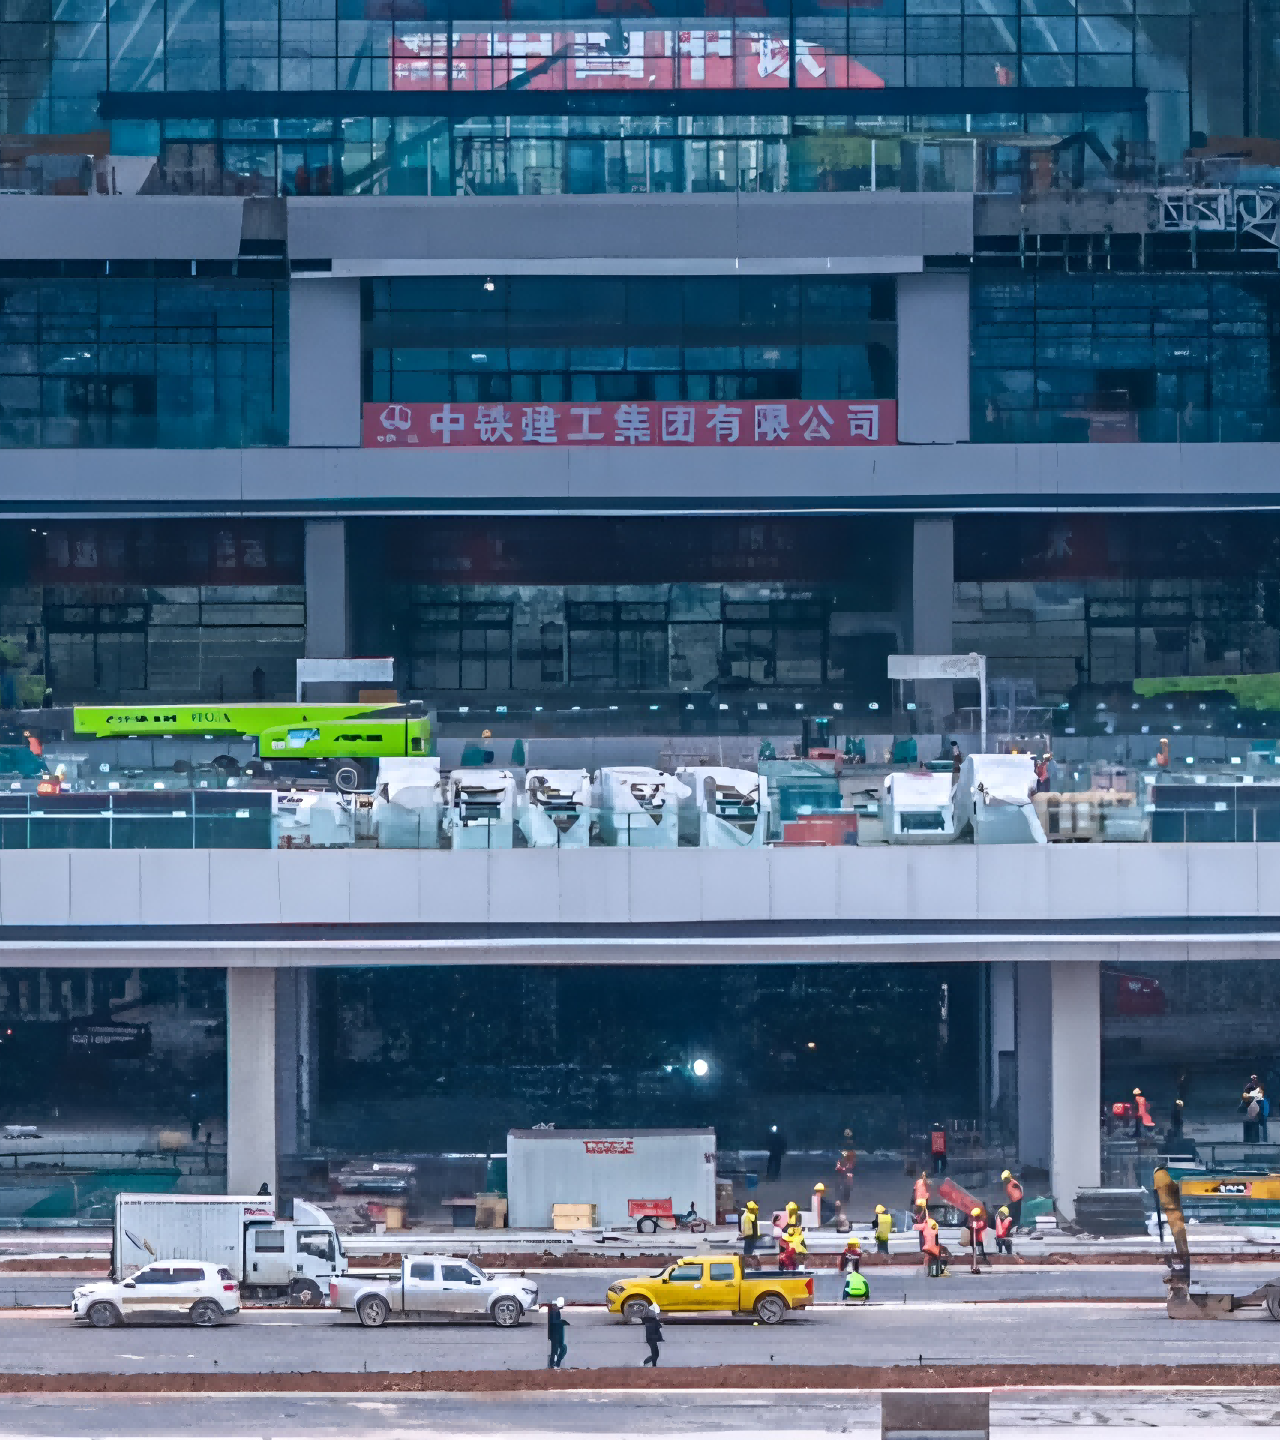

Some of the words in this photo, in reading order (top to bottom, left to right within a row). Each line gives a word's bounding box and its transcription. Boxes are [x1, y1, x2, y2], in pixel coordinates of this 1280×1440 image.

[429, 403, 880, 445] 中铁建工集团有限公司
